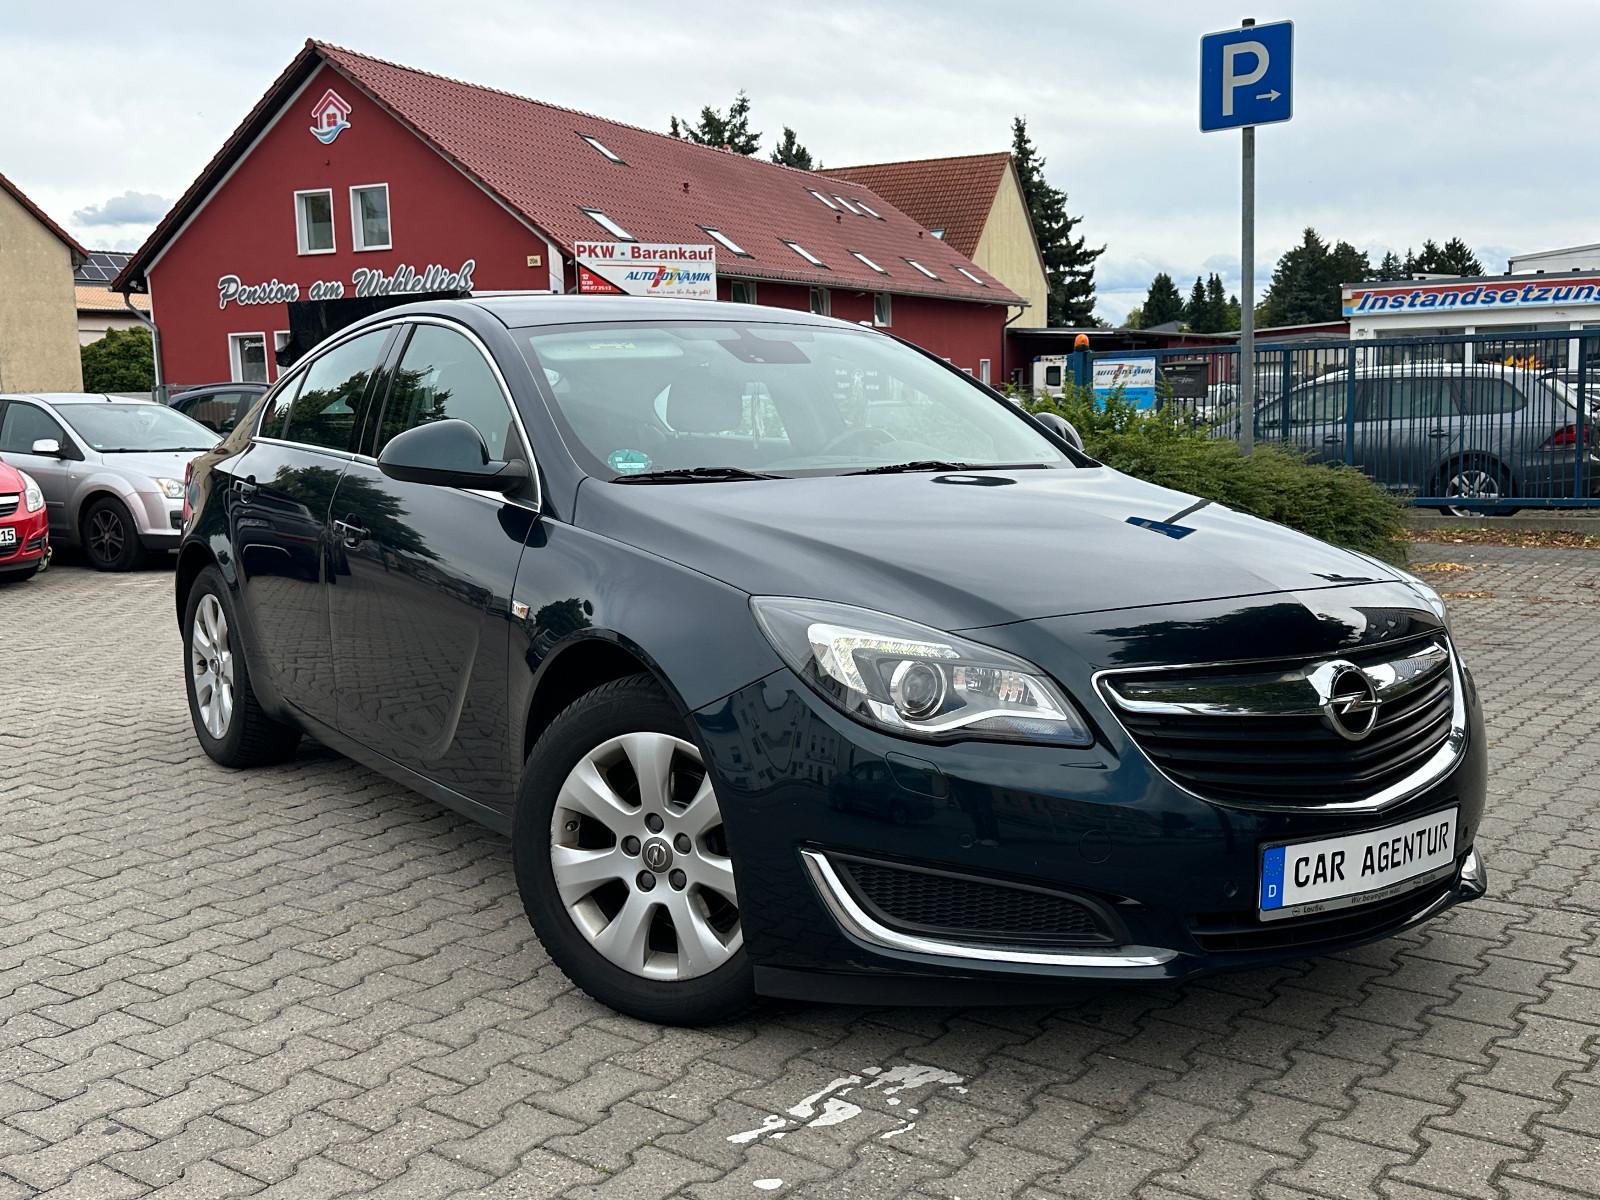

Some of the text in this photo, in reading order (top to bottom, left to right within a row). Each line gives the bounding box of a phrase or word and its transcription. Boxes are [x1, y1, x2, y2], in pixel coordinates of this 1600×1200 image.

[1222, 41, 1270, 116] P
[576, 244, 615, 259] PKW
[631, 246, 713, 260] Barankauf
[218, 274, 300, 310] Pension
[309, 280, 345, 301] am
[1, 529, 14, 541] 15
[1294, 821, 1449, 887] CAR AGENTUR
[1268, 884, 1277, 898] D
